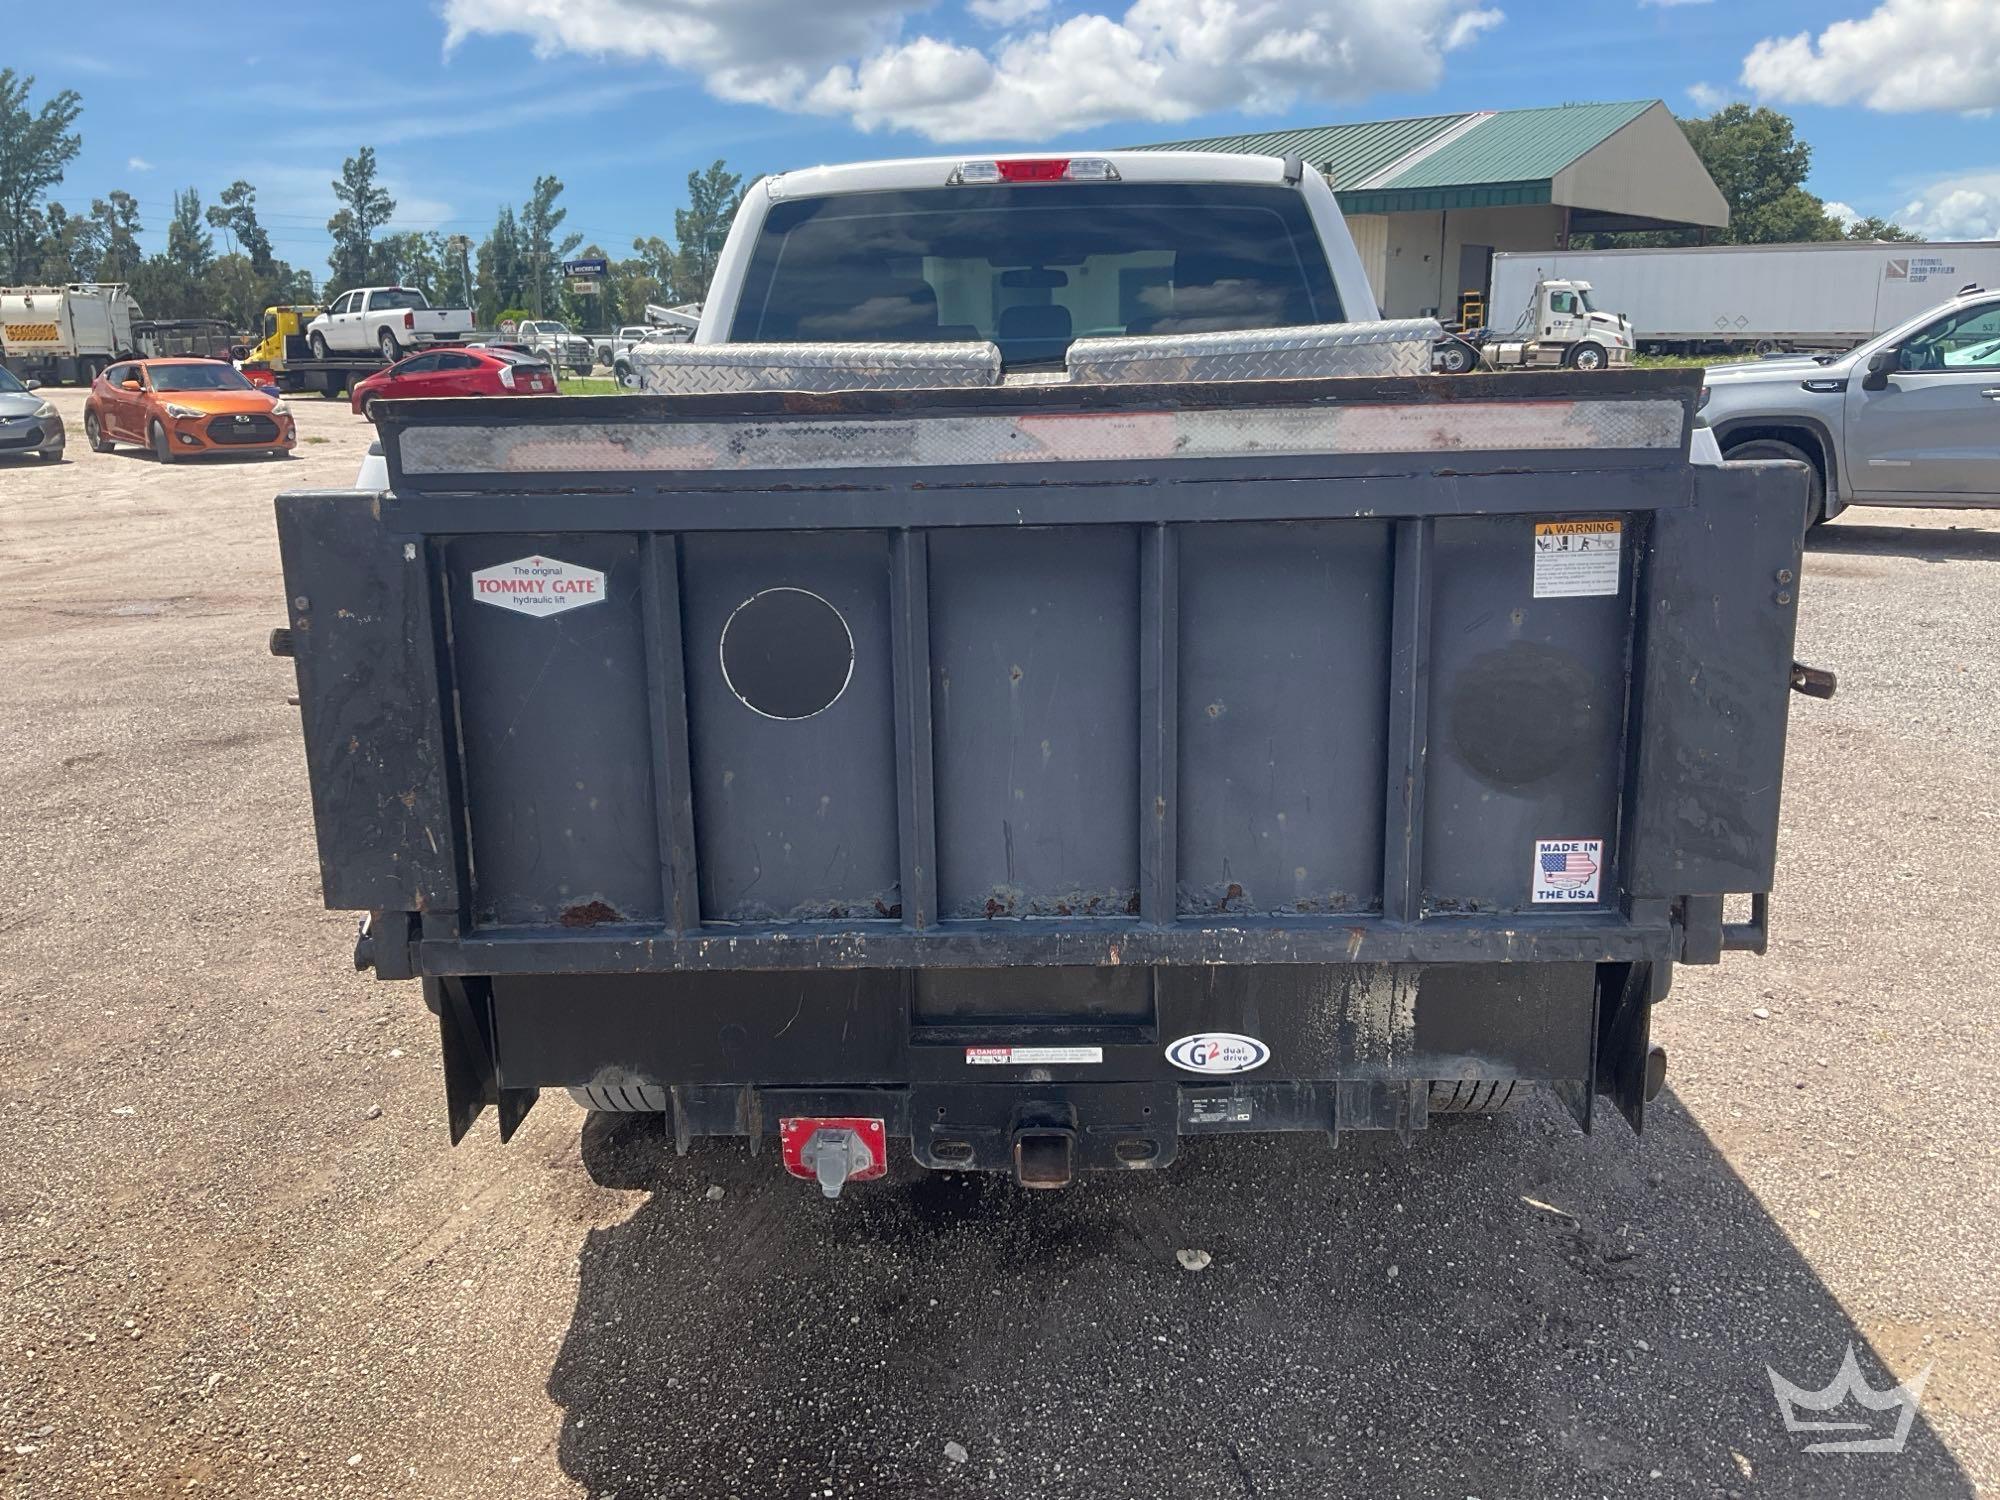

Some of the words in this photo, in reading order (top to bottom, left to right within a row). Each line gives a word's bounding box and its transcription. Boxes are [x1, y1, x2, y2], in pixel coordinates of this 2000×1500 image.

[1556, 522, 1614, 534] WARNING
[513, 567, 529, 575] The
[532, 567, 562, 576] original
[478, 579, 544, 593] TOMMY
[552, 580, 596, 593] GATE
[513, 596, 552, 605] hydraulic
[554, 595, 566, 604] lift
[1540, 843, 1579, 852] MADE
[1584, 843, 1598, 851] IN
[1538, 891, 1563, 899] THE
[1568, 891, 1595, 899] USA
